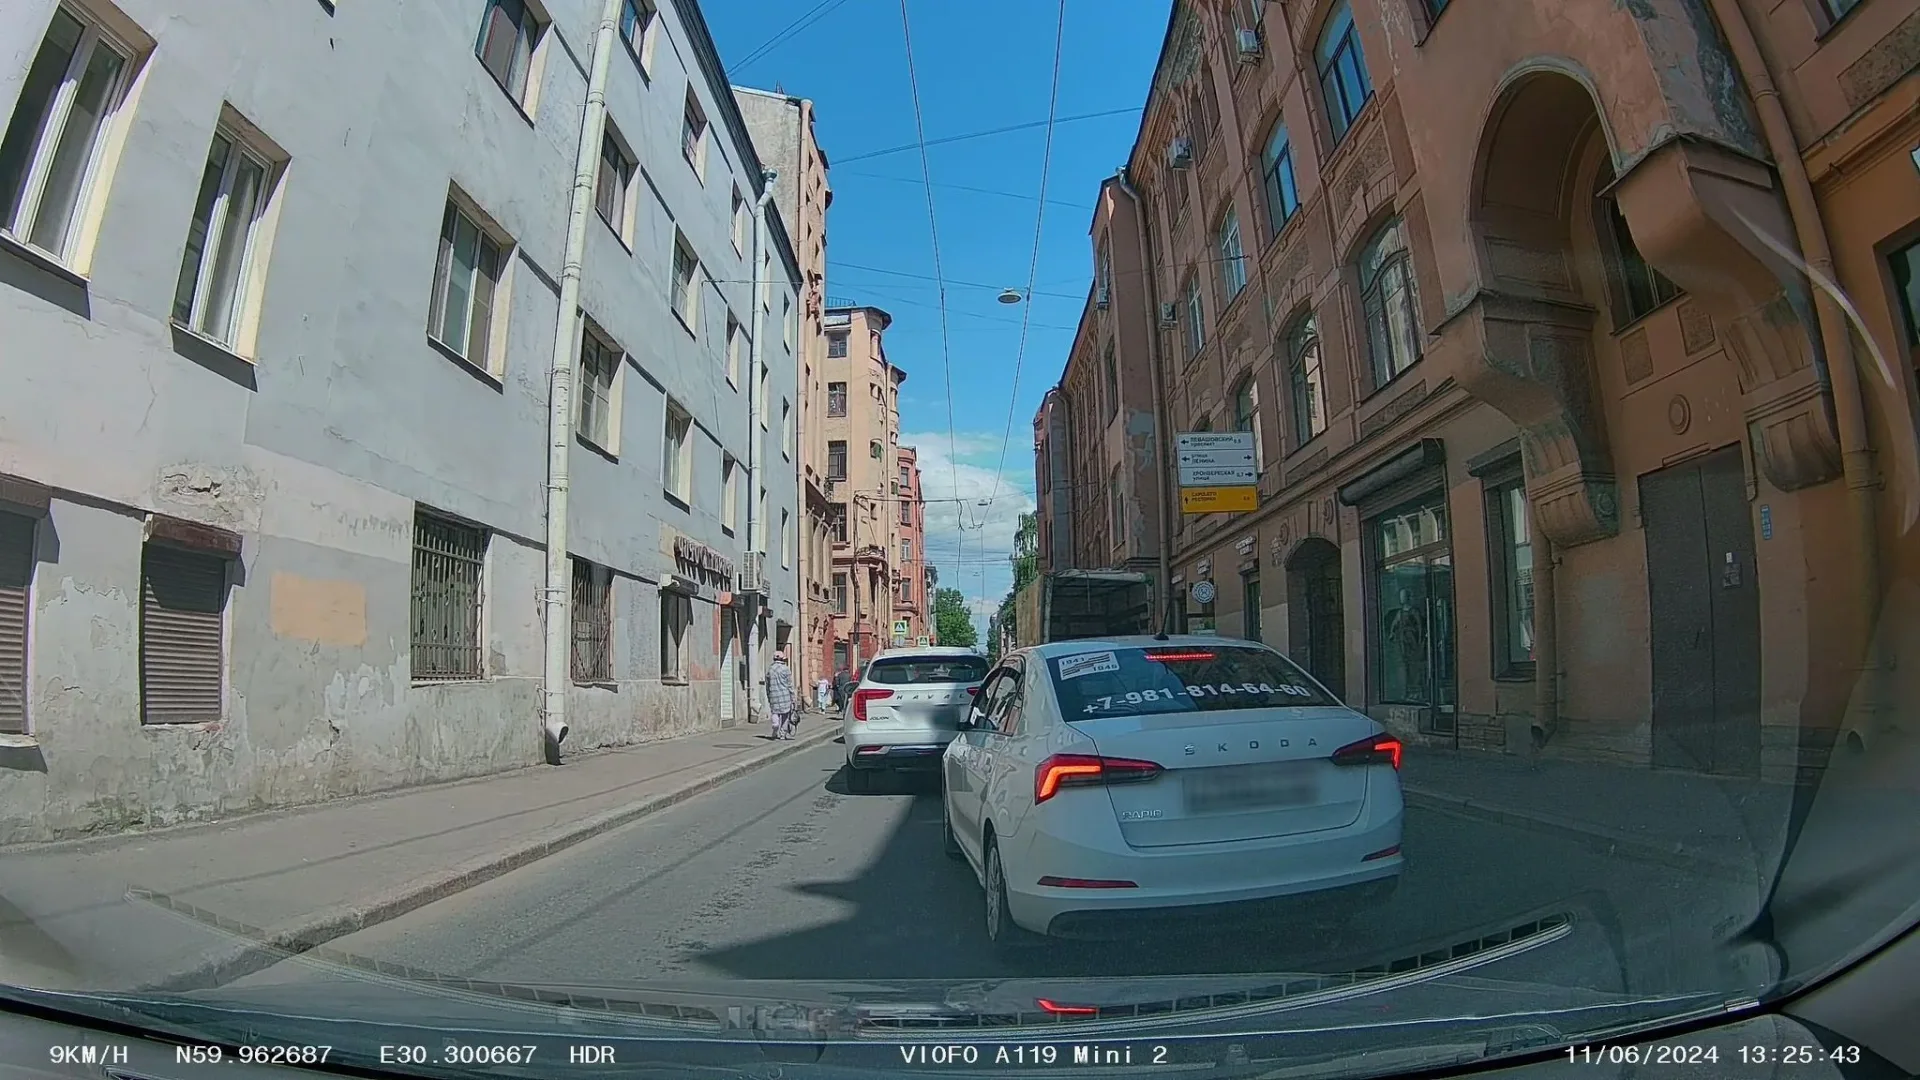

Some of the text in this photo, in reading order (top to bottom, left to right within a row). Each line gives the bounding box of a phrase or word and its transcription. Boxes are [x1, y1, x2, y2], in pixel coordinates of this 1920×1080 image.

[1061, 657, 1085, 666] 1941
[1184, 738, 1318, 756] SKODA
[1122, 809, 1163, 820] RAPID
